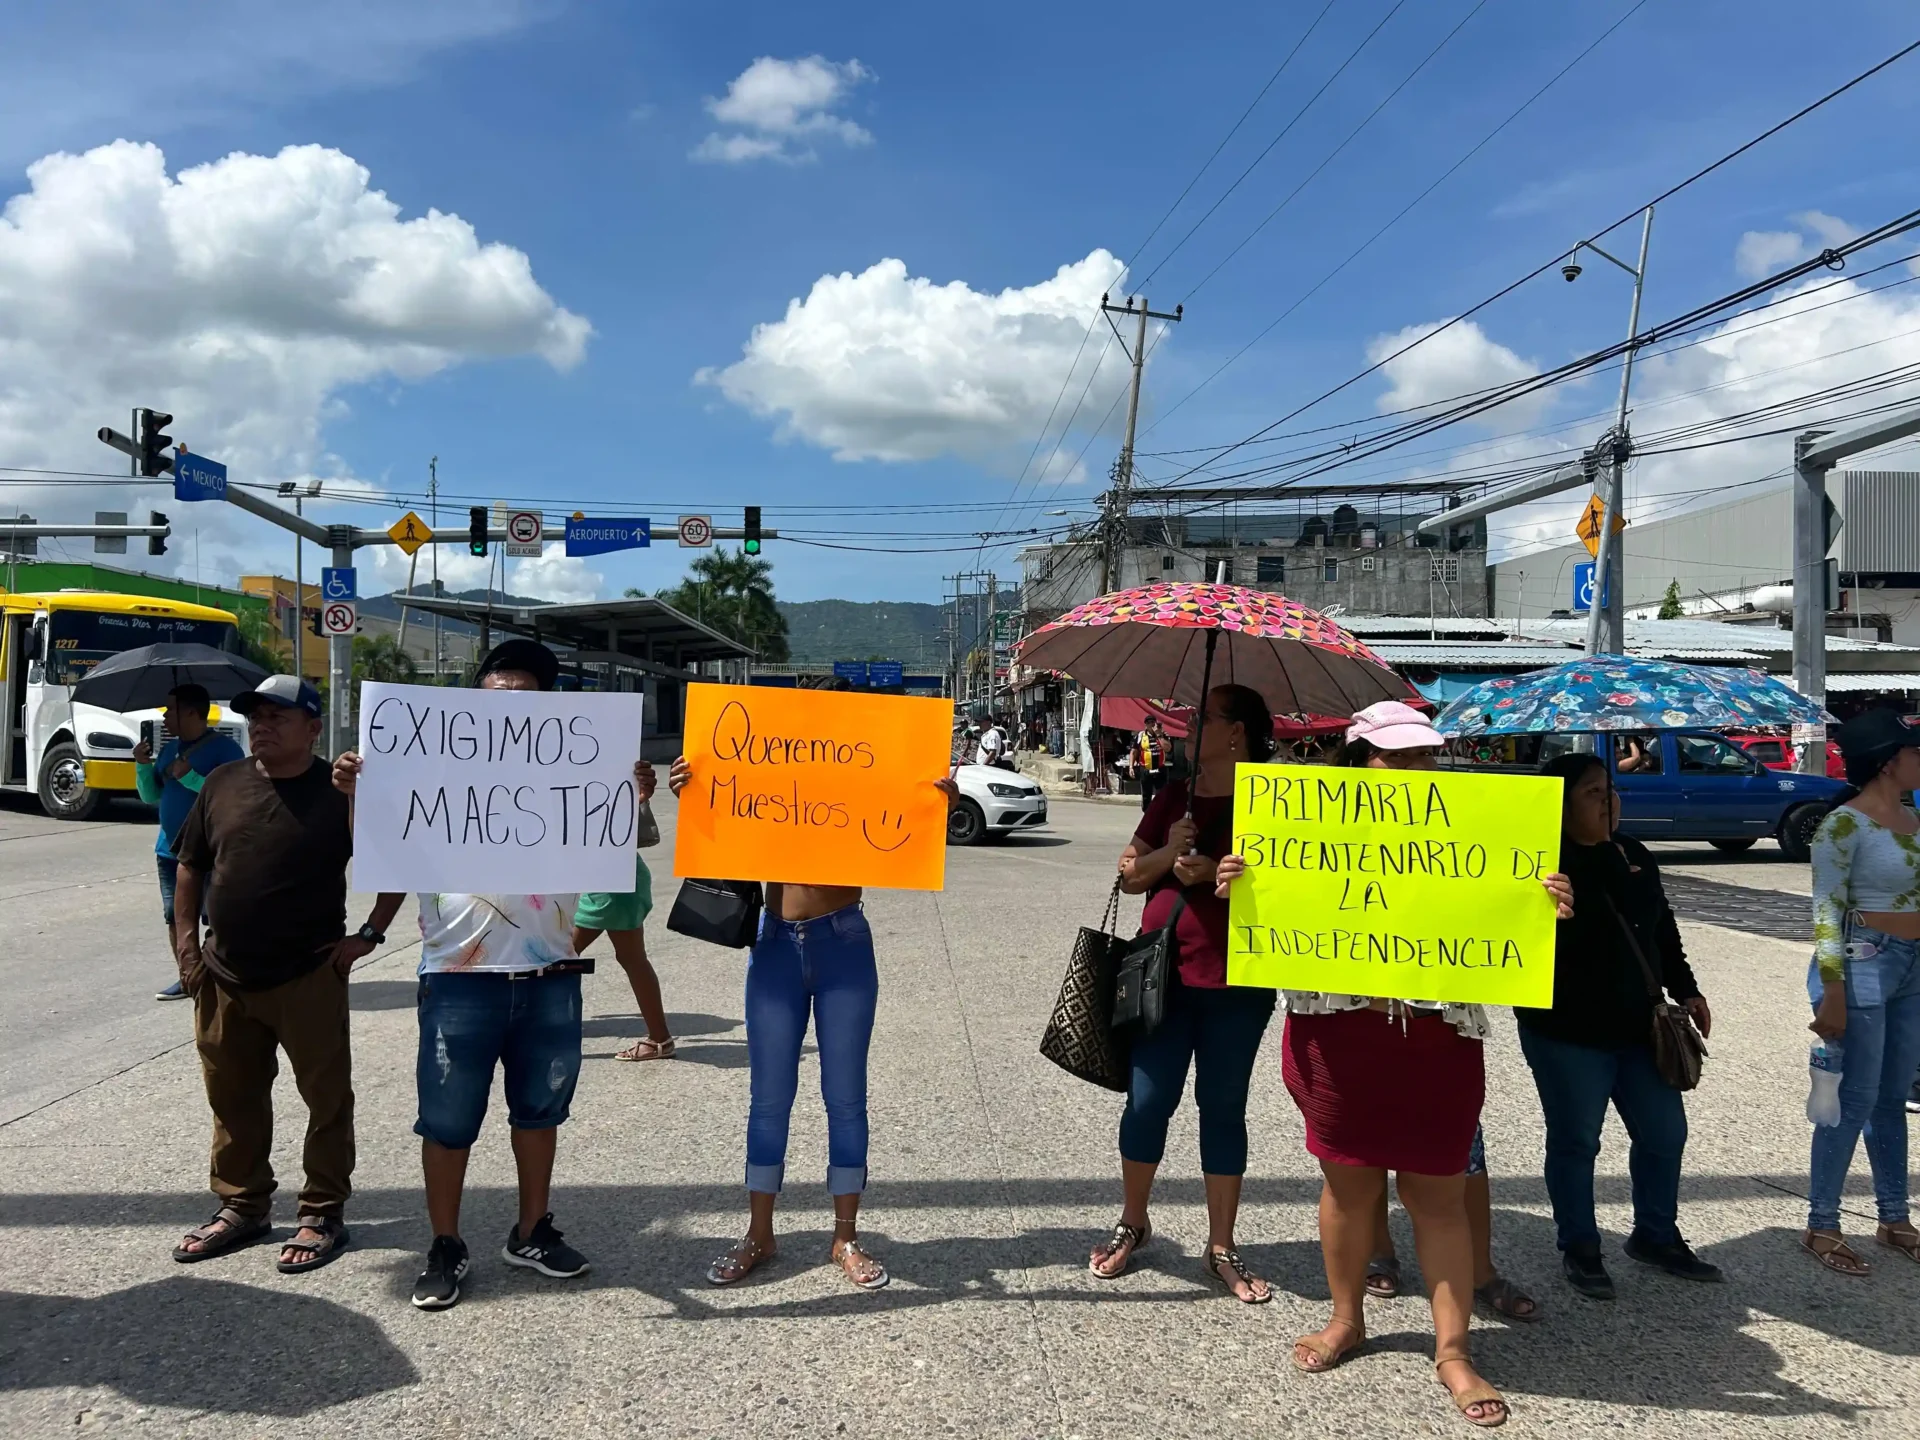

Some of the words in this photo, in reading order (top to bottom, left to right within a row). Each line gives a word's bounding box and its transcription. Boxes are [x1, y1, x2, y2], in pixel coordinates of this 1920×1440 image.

[192, 468, 224, 492] MEXICO
[569, 528, 628, 541] AEROPUERTO
[687, 523, 703, 536] 60
[508, 547, 521, 555] SOLO
[131, 617, 152, 629] Dios
[157, 622, 174, 631] por
[55, 639, 79, 649] 1217
[369, 697, 600, 766] EXIGIMOS
[712, 700, 875, 769] Queremos
[402, 780, 635, 848] MAESTRO
[710, 774, 850, 829] Maestros
[1240, 774, 1451, 828] PRIMARIA
[1235, 833, 1487, 879] BICENTENARIO
[1510, 847, 1550, 881] DE
[1338, 878, 1389, 912] LA
[1235, 925, 1524, 969] INDEPENDENCIA
